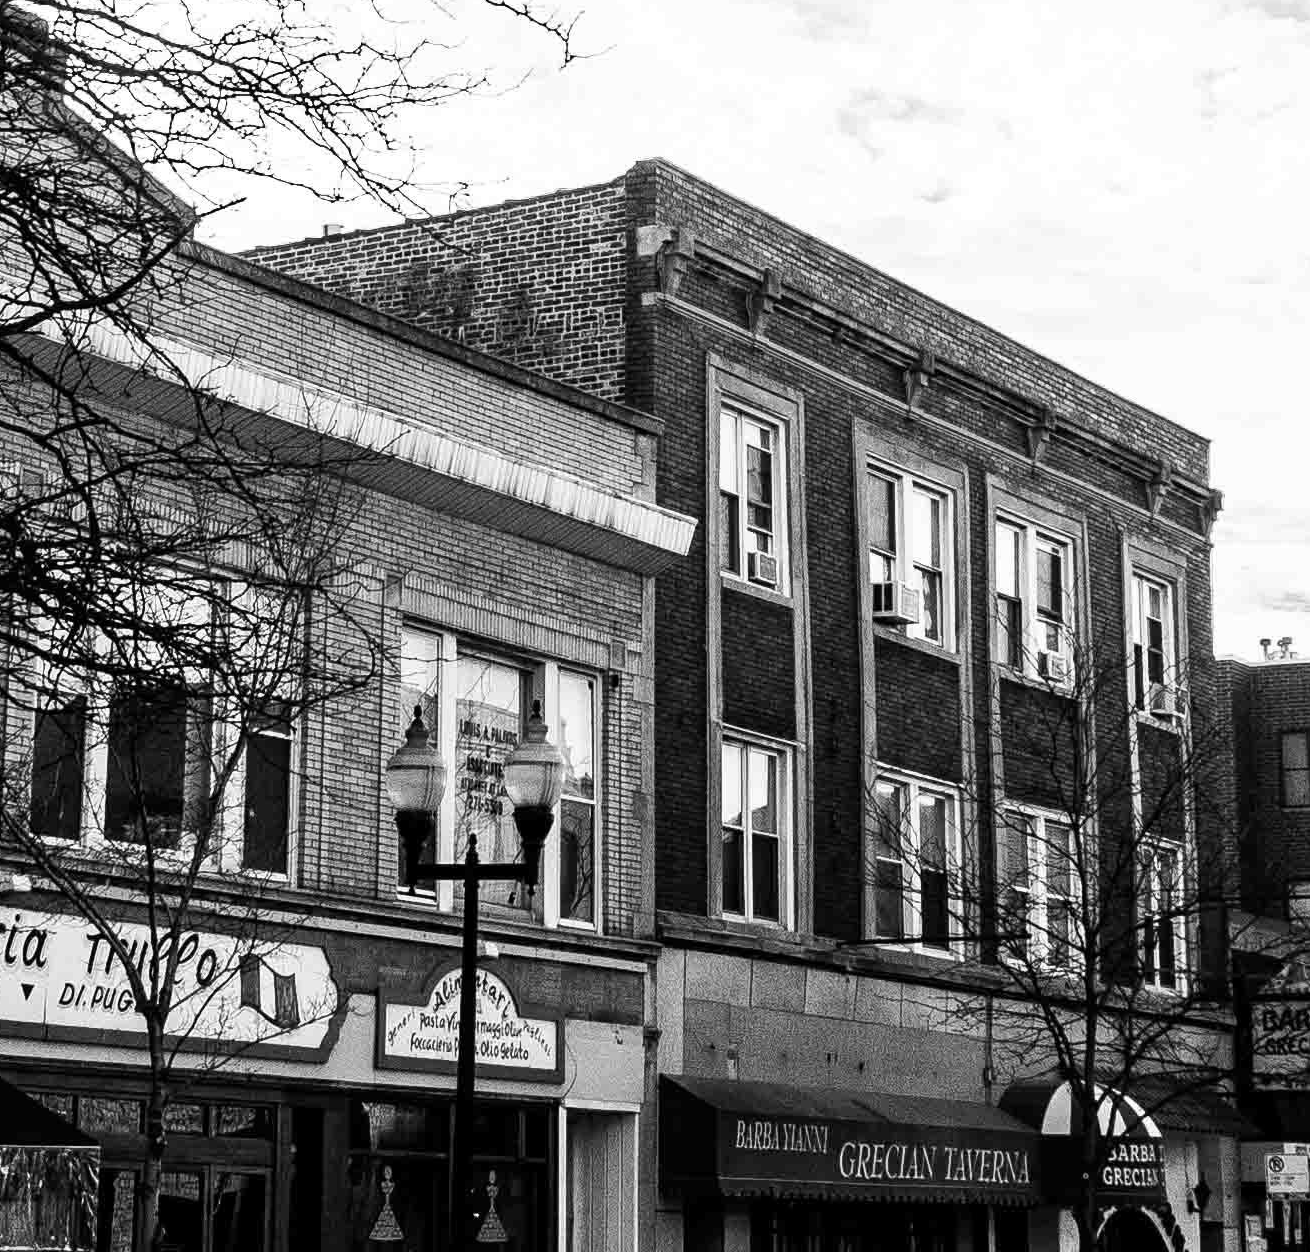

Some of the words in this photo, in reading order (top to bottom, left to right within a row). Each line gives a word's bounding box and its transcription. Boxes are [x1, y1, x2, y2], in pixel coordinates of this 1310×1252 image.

[736, 1120, 780, 1150] BARBA
[783, 1124, 829, 1154] YIANNI
[839, 1142, 938, 1180] GRECIAN
[944, 1147, 1031, 1184] TAVERNA
